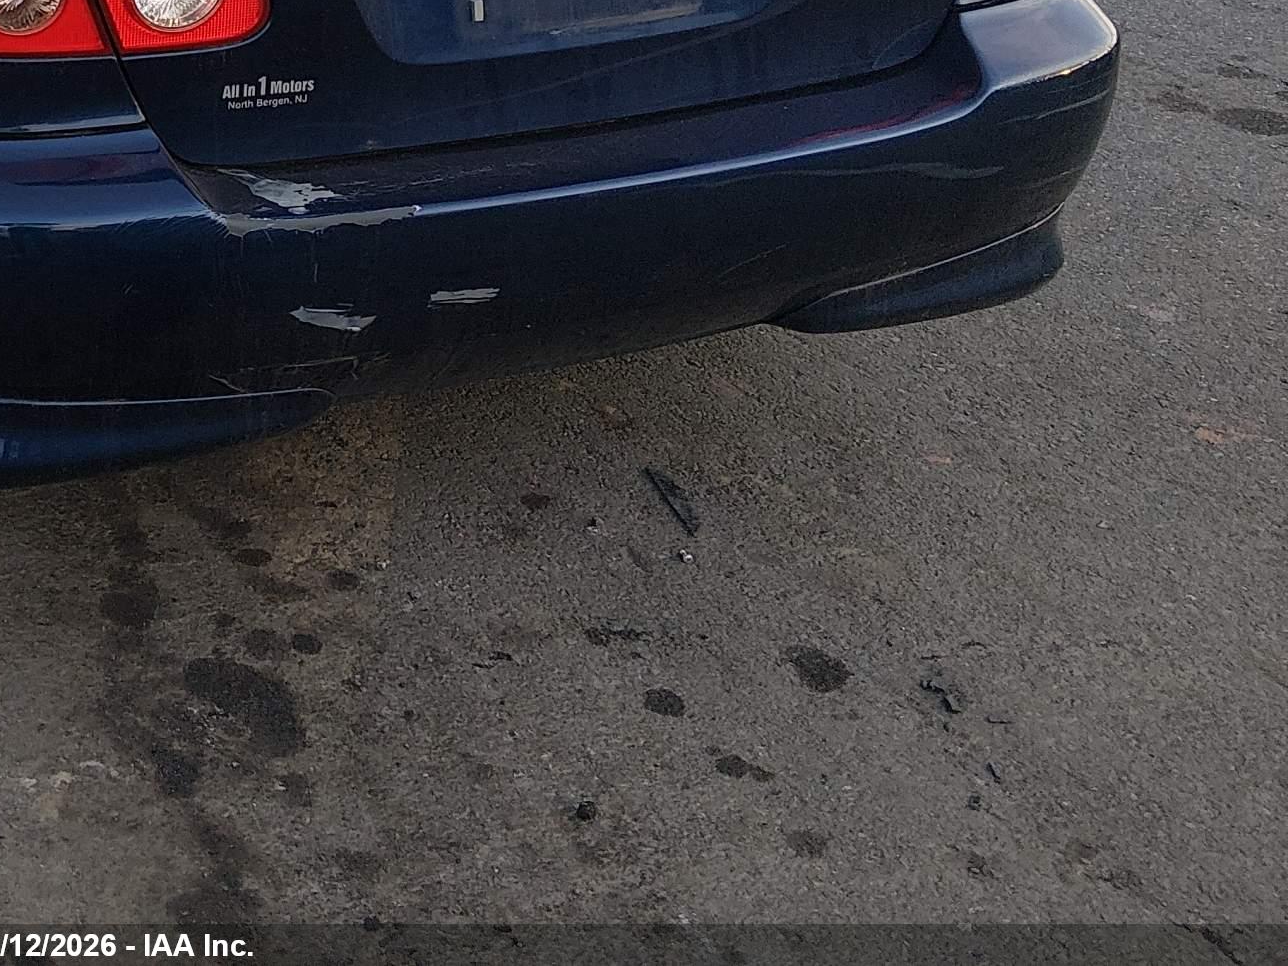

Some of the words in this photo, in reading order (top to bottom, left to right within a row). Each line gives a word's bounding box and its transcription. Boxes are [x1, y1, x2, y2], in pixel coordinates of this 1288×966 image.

[222, 84, 240, 99] All
[243, 83, 256, 97] In
[258, 76, 267, 96] 1
[270, 79, 314, 94] Motors
[227, 100, 254, 110] North
[256, 96, 293, 108] Bergen,
[294, 94, 308, 104] NJ
